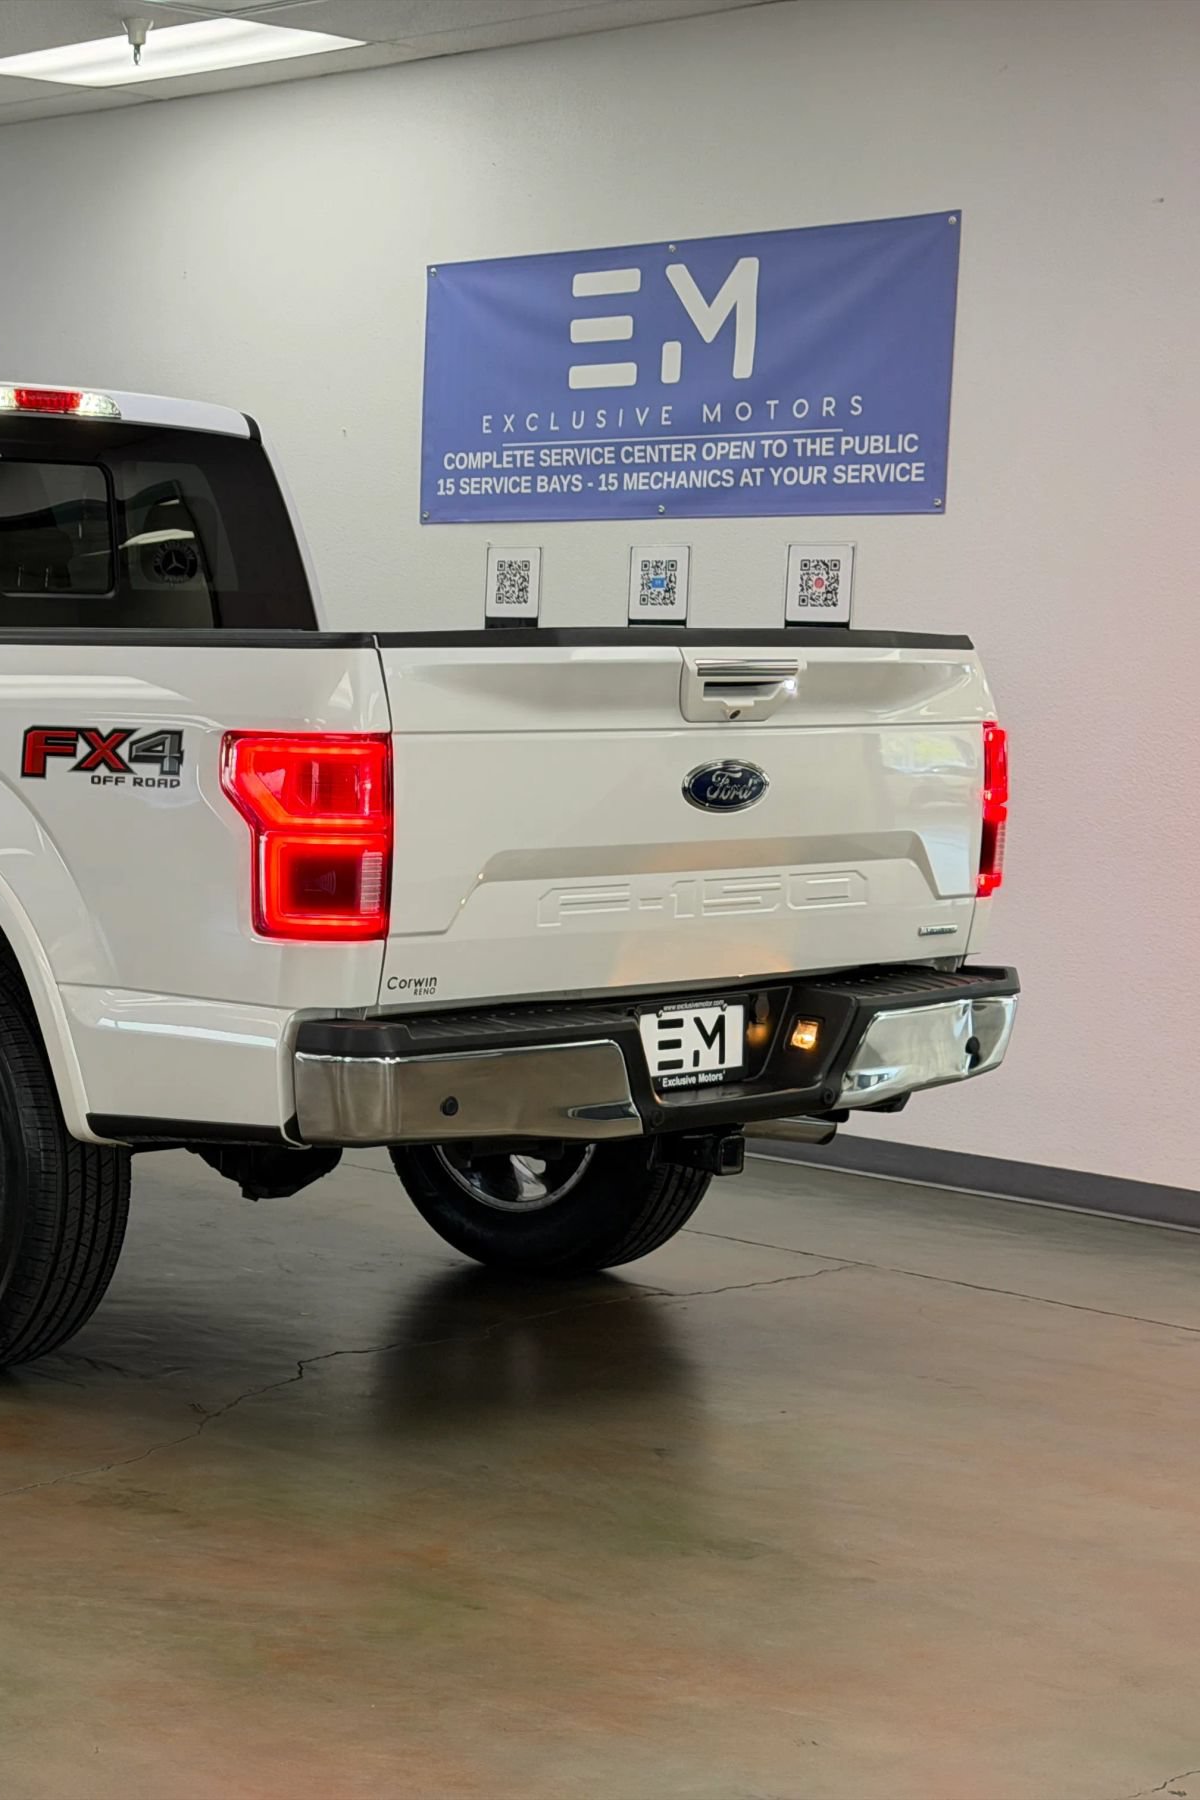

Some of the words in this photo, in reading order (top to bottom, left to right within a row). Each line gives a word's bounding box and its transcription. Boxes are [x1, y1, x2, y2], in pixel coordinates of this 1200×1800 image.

[569, 257, 759, 389] EM
[482, 405, 673, 434] EXCLUSIVE
[702, 395, 863, 424] MOTORS
[443, 450, 535, 471] COMPLETE
[538, 446, 616, 467] SERVICE
[620, 443, 697, 465] CENTER
[701, 440, 756, 462] OPEN
[761, 438, 788, 459] TO
[793, 436, 835, 457] THE
[840, 433, 920, 456] PUBLIC
[436, 478, 455, 496] 15
[458, 476, 532, 496] SERVICE
[536, 473, 583, 493] BAYS
[597, 471, 618, 492] 15
[623, 468, 735, 491] MECHANICS
[738, 467, 765, 488] AT
[769, 465, 828, 487] YOUR
[832, 461, 926, 485] SERVICE
[21, 725, 185, 780] FX4
[90, 774, 126, 786] OFF
[133, 776, 181, 789] ROAD
[706, 770, 753, 801] Ford
[537, 869, 868, 928] F-150
[386, 976, 438, 991] Corwin
[413, 987, 436, 996] RENO
[657, 1014, 726, 1072] EM
[662, 1075, 697, 1088] Exclusive
[698, 1072, 724, 1084] Motors
